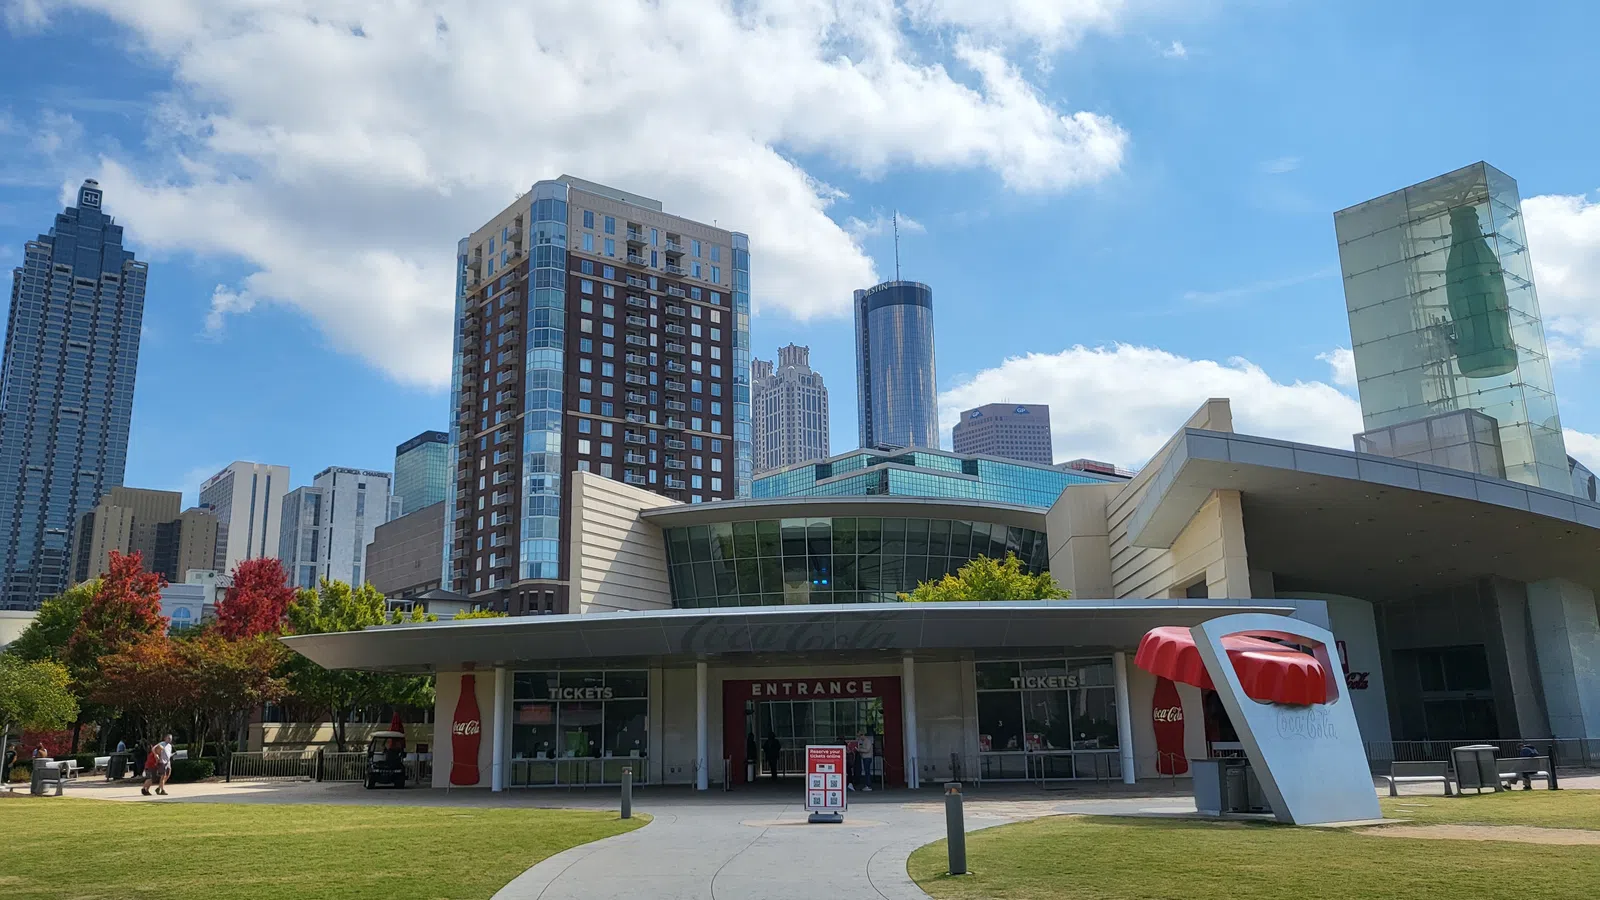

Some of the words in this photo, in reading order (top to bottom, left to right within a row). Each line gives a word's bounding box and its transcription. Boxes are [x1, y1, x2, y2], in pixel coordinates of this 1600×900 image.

[336, 467, 361, 476] GEORGIA
[751, 681, 873, 696] ENTRANCE
[1010, 676, 1078, 689] TICKETS
[548, 687, 613, 699] TICKETS
